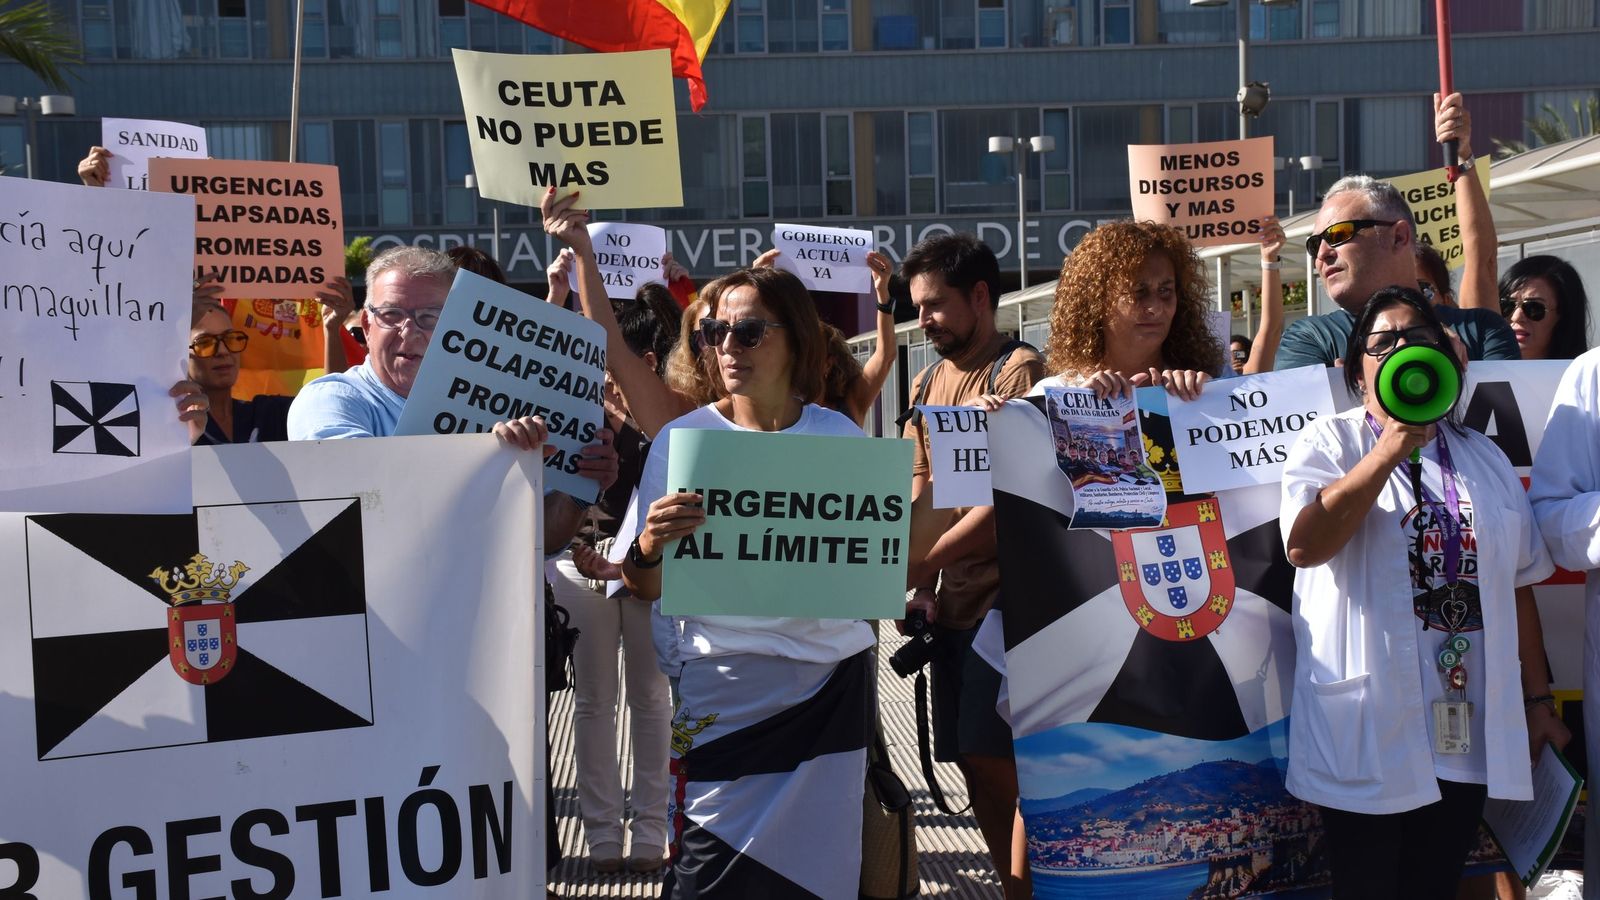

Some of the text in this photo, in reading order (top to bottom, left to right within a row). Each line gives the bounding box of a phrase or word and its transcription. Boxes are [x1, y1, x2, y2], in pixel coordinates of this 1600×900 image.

[498, 80, 626, 107] CEUTA
[118, 130, 199, 152] SANIDAD
[476, 115, 664, 148] NO PUEDE
[1160, 151, 1240, 171] MENOS
[127, 173, 148, 191] LÍ
[528, 161, 610, 188] MAS
[1139, 172, 1264, 195] DISCURSOS
[170, 175, 324, 198] URGENCIAS
[196, 204, 337, 229] LAPSADAS,
[1165, 199, 1235, 218] Y MAS
[1414, 203, 1456, 225] UCH
[605, 233, 631, 248] NO
[781, 230, 866, 247] GOBIERNO
[977, 220, 1041, 260] DE
[1173, 219, 1261, 239] URSOS
[62, 228, 150, 285] aquí
[196, 237, 322, 257] ROMESAS
[796, 248, 851, 263] ACTUÁ
[593, 252, 660, 270] DEMOS
[193, 265, 325, 284] LVIDADAS
[599, 270, 634, 287] MÁS
[812, 266, 832, 280] YA
[4, 282, 165, 341] maquillan
[472, 301, 606, 372] URGENCIAS
[441, 330, 605, 407] COLAPSADAS
[447, 377, 597, 444] PROMESAS
[1061, 408, 1070, 416] OS
[1080, 409, 1091, 417] LAS
[1092, 409, 1120, 417] GRACIAS
[1063, 392, 1114, 410] CEUTA
[1228, 390, 1268, 412] NO
[932, 410, 988, 433] EUR
[1187, 410, 1318, 446] PODEMOS
[953, 448, 990, 472] HE
[1228, 442, 1288, 470] MÁS
[673, 528, 900, 565] AL LÍMITE !!
[88, 764, 513, 900] GESTIÓN
